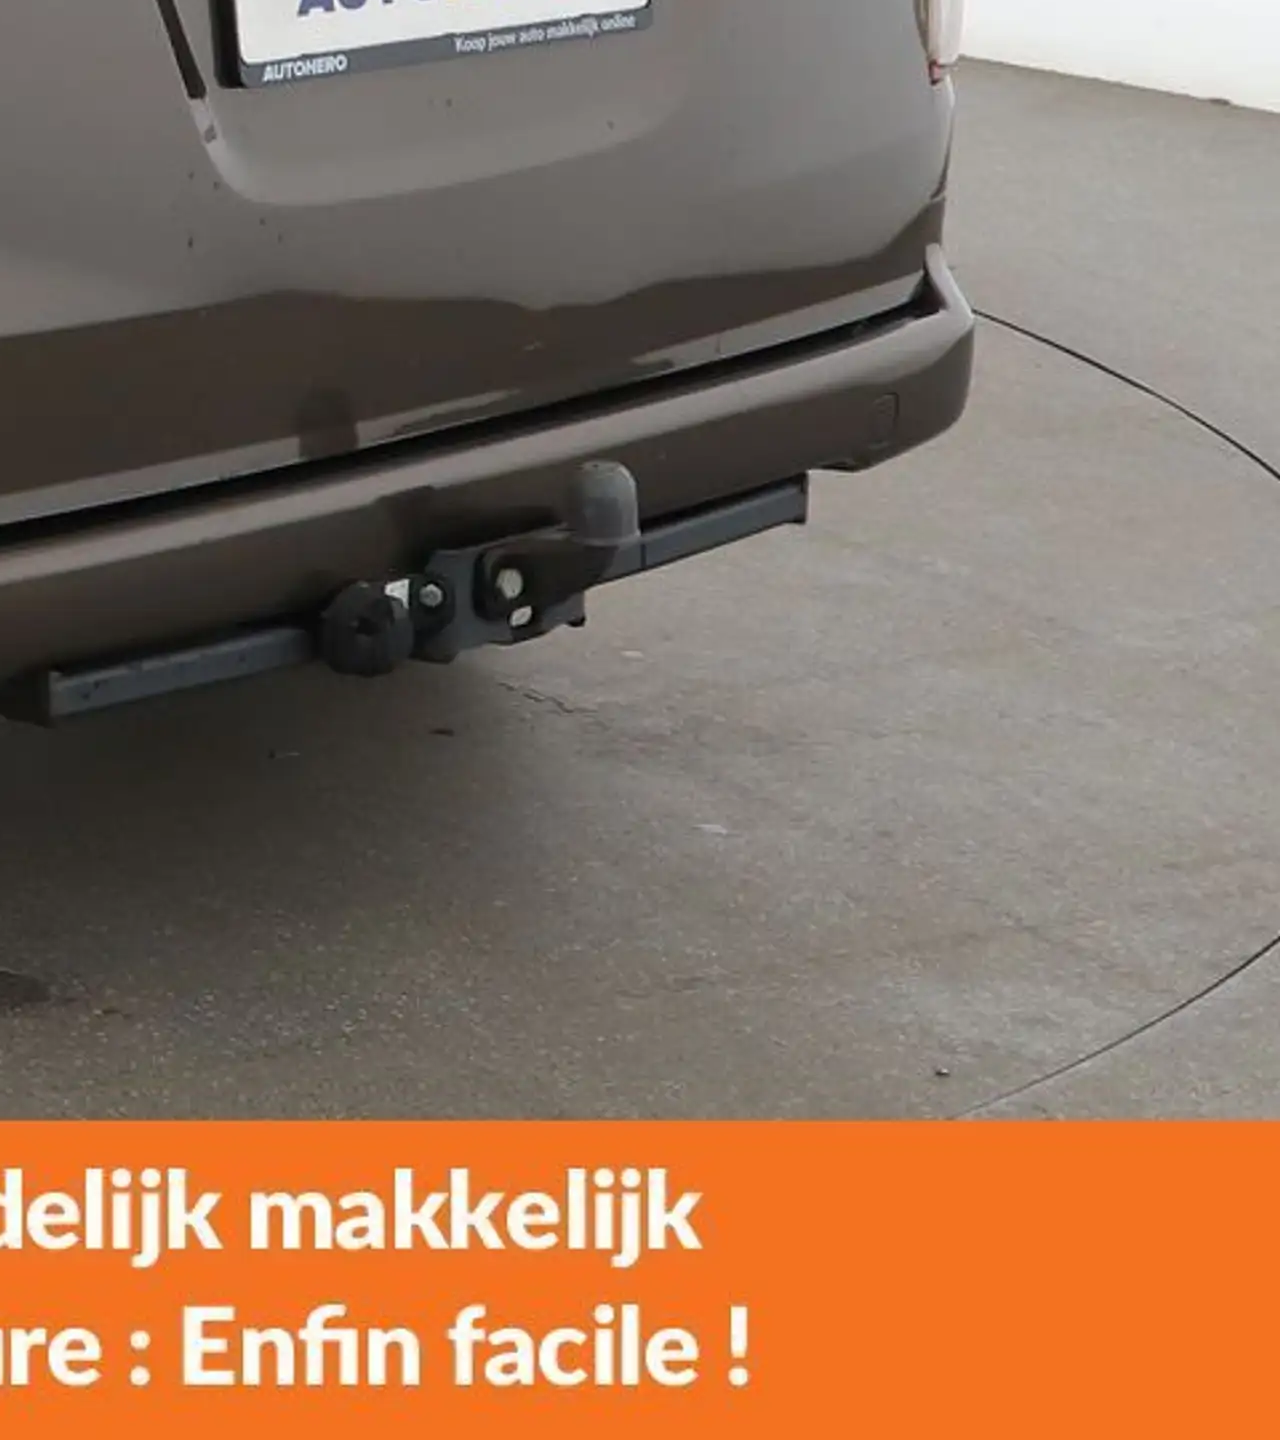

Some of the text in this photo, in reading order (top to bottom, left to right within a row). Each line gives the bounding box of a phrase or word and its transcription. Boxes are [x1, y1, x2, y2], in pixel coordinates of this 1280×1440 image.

[453, 34, 486, 53] Koop
[487, 32, 516, 51] jouw
[519, 26, 545, 43] auto
[600, 13, 636, 31] online
[262, 54, 348, 82] AUTOHERO
